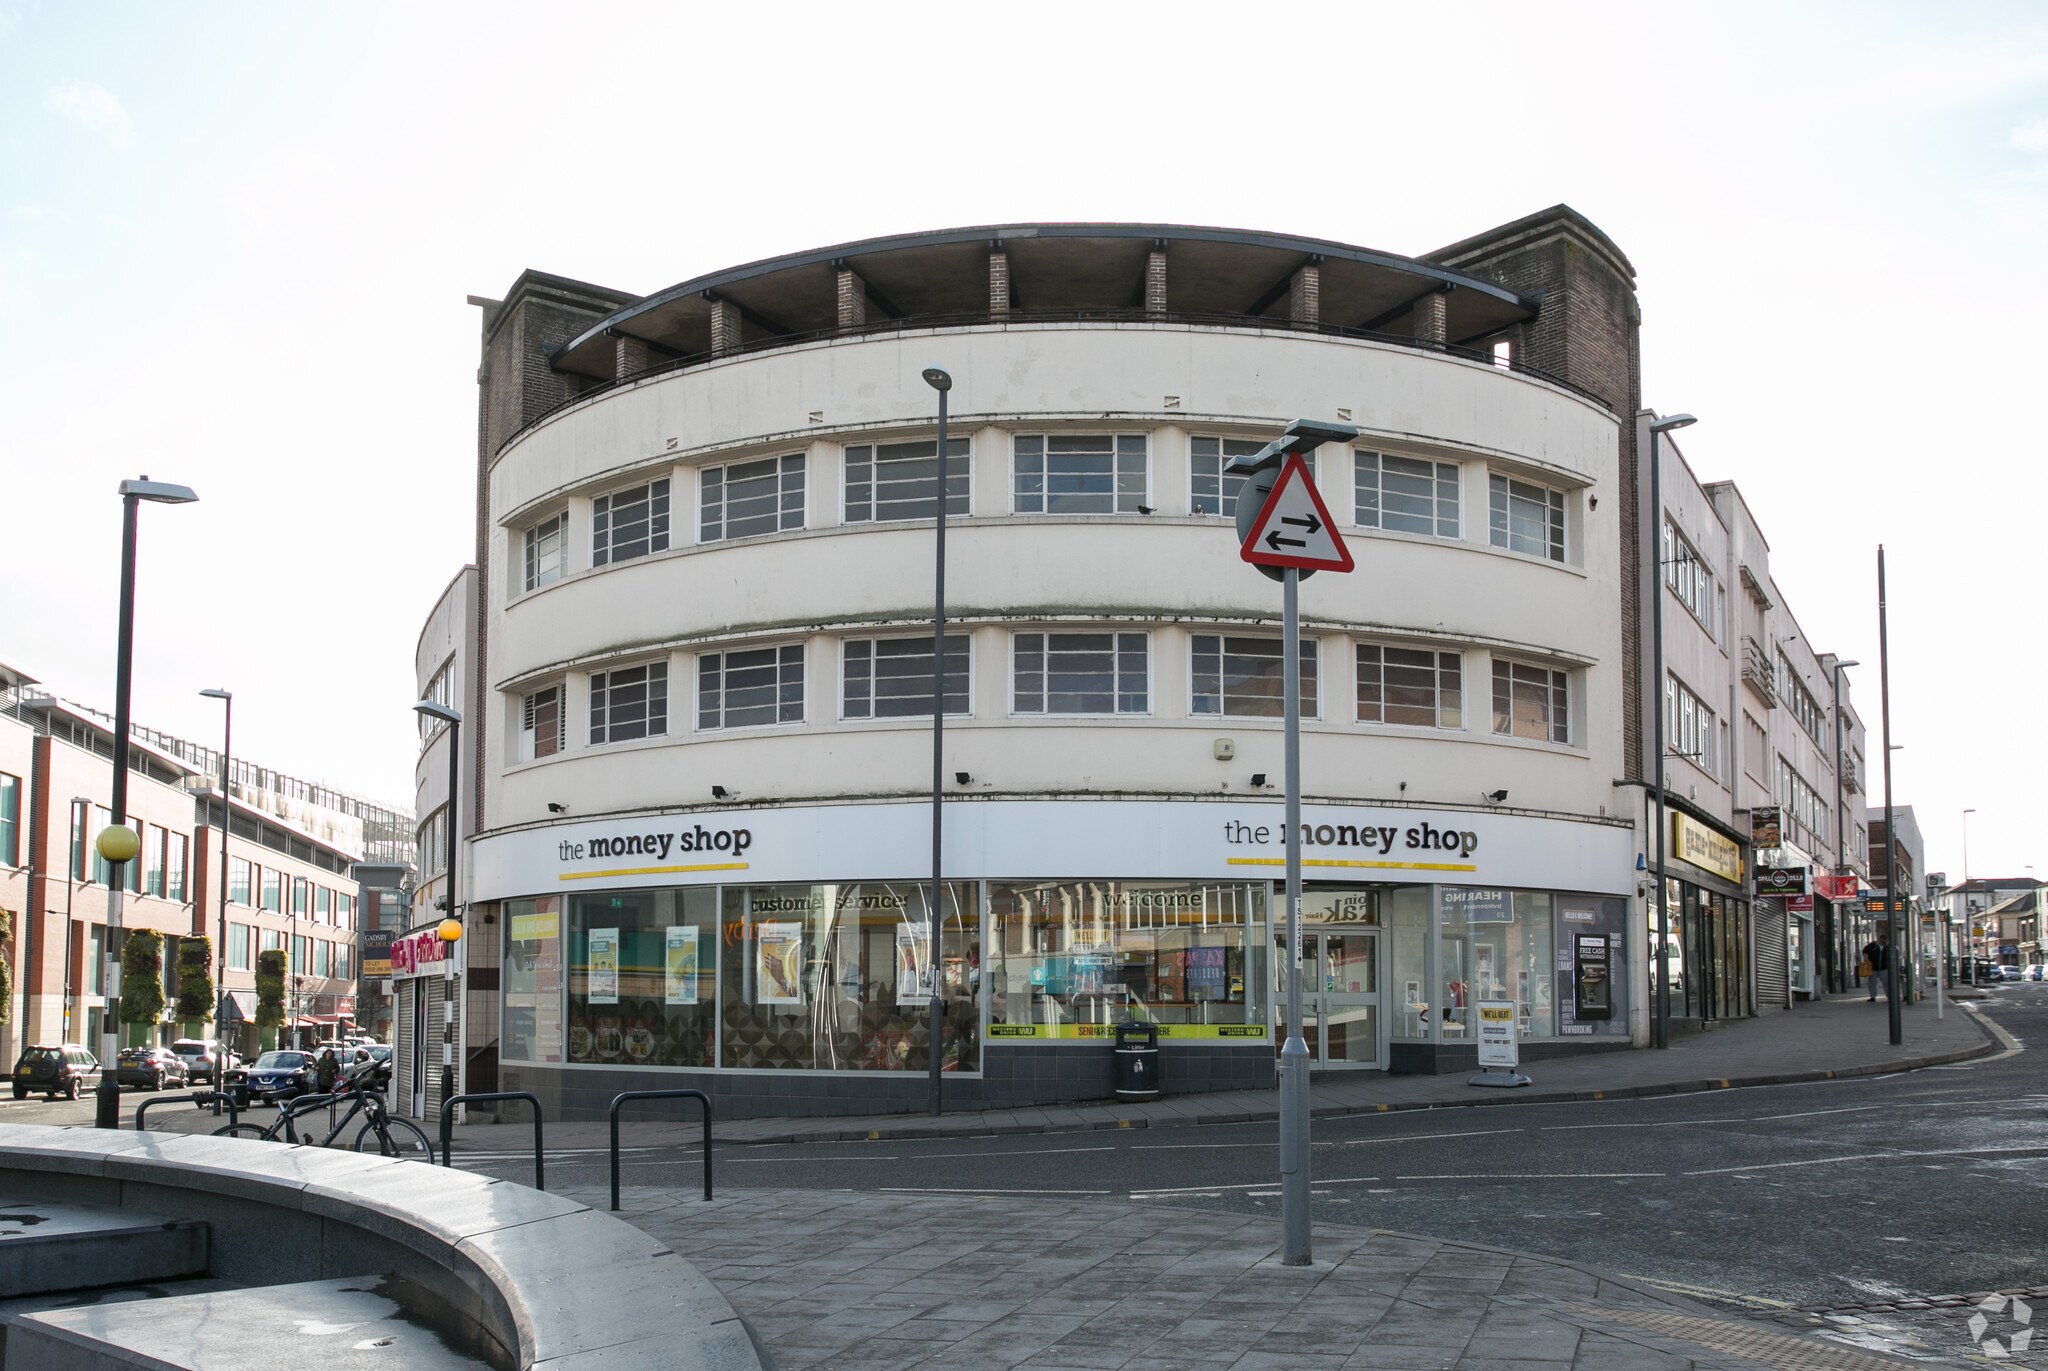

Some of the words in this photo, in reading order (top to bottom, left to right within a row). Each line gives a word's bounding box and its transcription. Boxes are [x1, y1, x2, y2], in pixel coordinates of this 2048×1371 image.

[558, 840, 583, 861] the
[589, 833, 674, 860] money
[680, 825, 752, 856] shop
[1224, 820, 1270, 844] the
[1280, 823, 1398, 854] money
[1406, 822, 1478, 858] shop
[1103, 889, 1202, 907] welcome
[1558, 961, 1573, 971] LOANS
